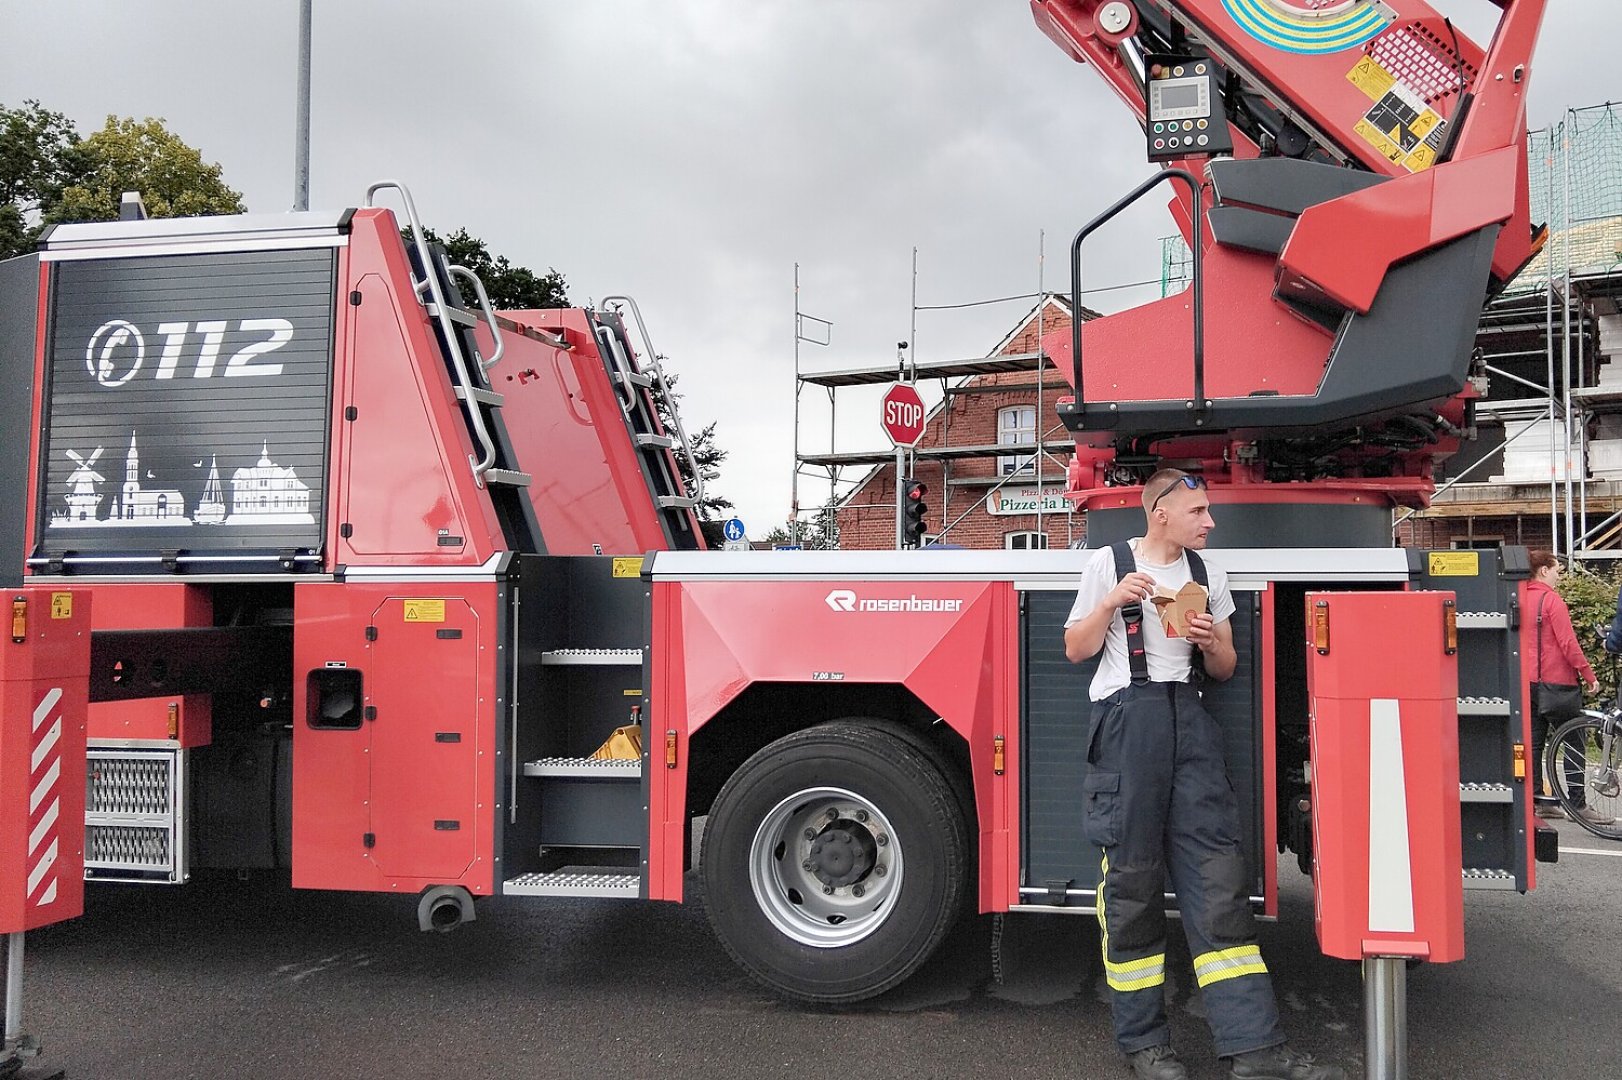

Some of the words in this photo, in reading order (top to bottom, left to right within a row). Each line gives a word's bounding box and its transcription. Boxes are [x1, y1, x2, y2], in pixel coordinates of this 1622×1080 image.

[155, 318, 294, 379] 112
[886, 400, 922, 429] STOP
[859, 594, 963, 612] rosenbauer
[831, 672, 844, 680] bar
